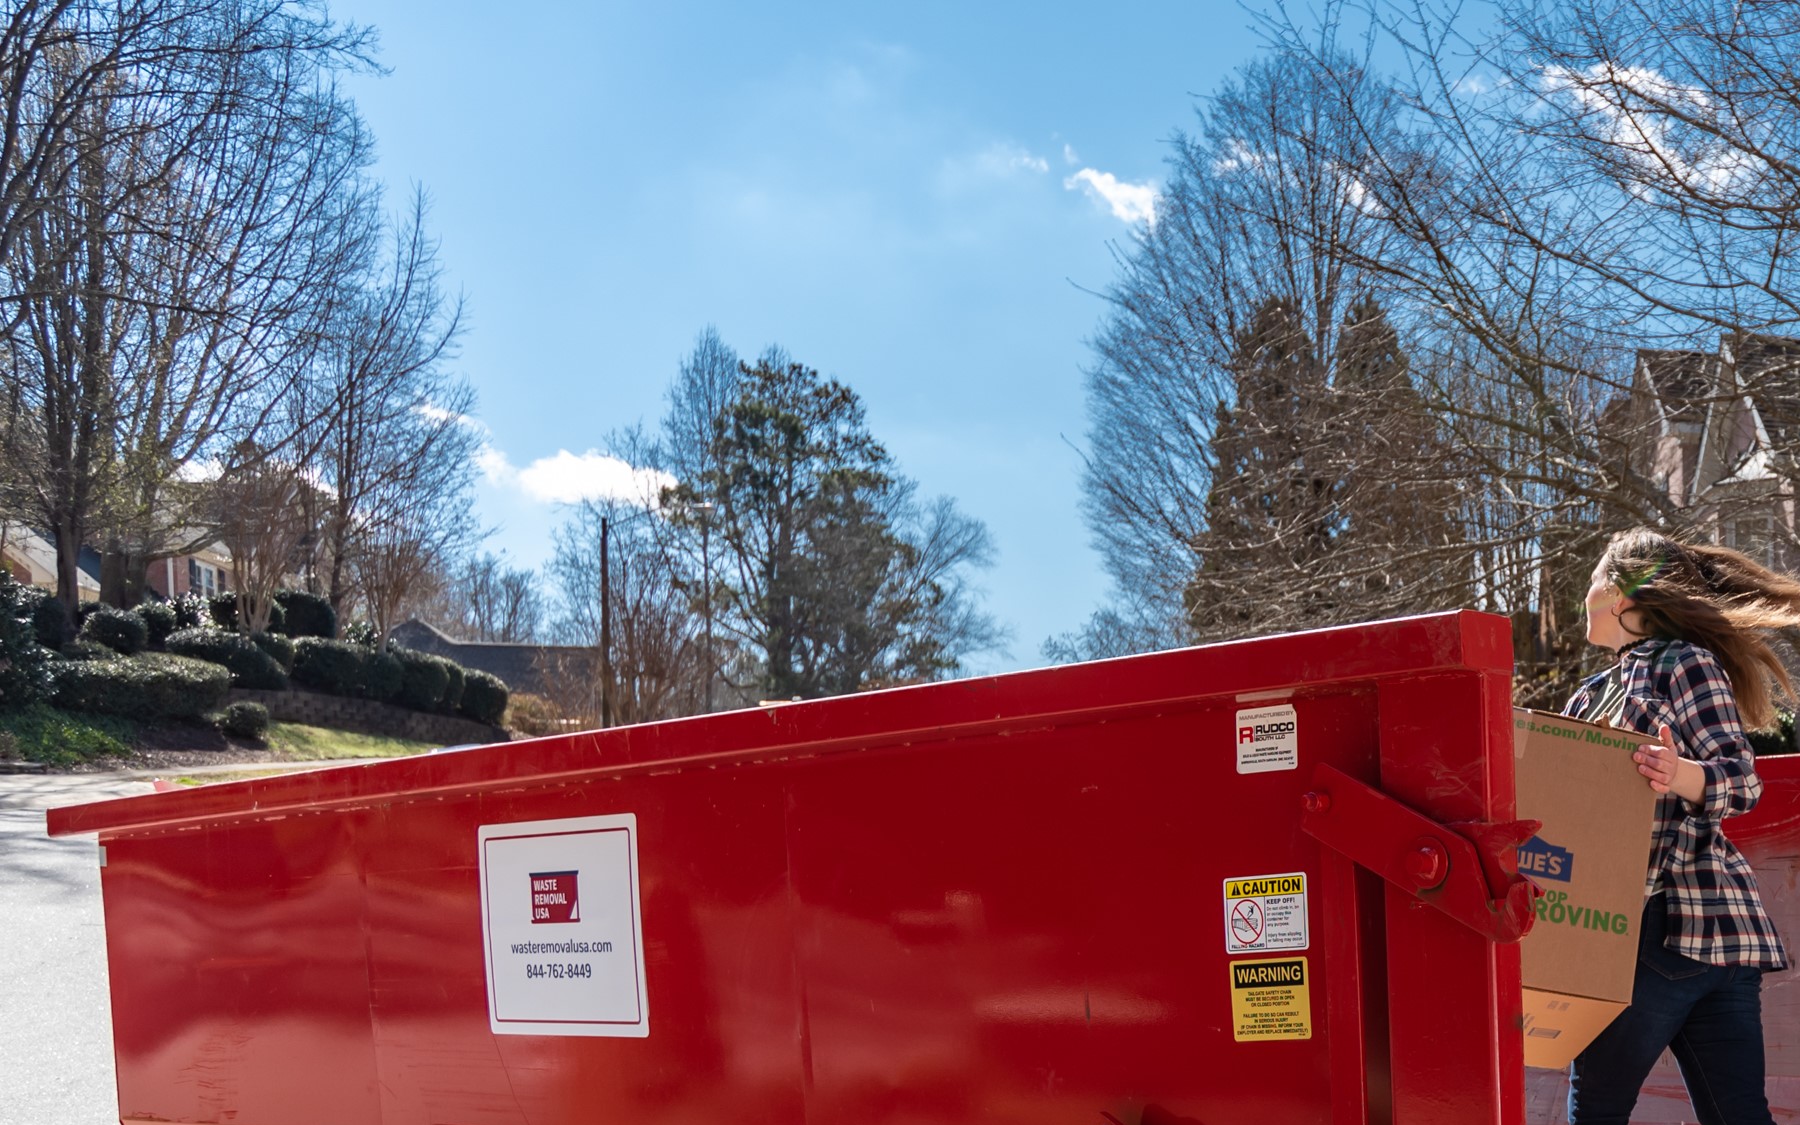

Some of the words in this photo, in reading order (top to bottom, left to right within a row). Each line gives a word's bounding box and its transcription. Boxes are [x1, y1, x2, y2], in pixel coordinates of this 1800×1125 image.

[1239, 712, 1285, 720] MANUFACTURED
[1239, 727, 1253, 744] R
[1256, 722, 1294, 734] RUDCO
[1514, 719, 1639, 752] es.com/Movin
[1518, 851, 1562, 875] WE'S
[533, 879, 557, 891] WASTE
[1242, 878, 1300, 895] CAUTION
[534, 893, 567, 905] REMOVAL
[535, 908, 550, 920] USA
[1536, 898, 1628, 935] ROVING
[511, 939, 612, 954] wasteremovalusa.com
[526, 963, 592, 979] 844-762-8449
[1236, 965, 1301, 984] WARNING
